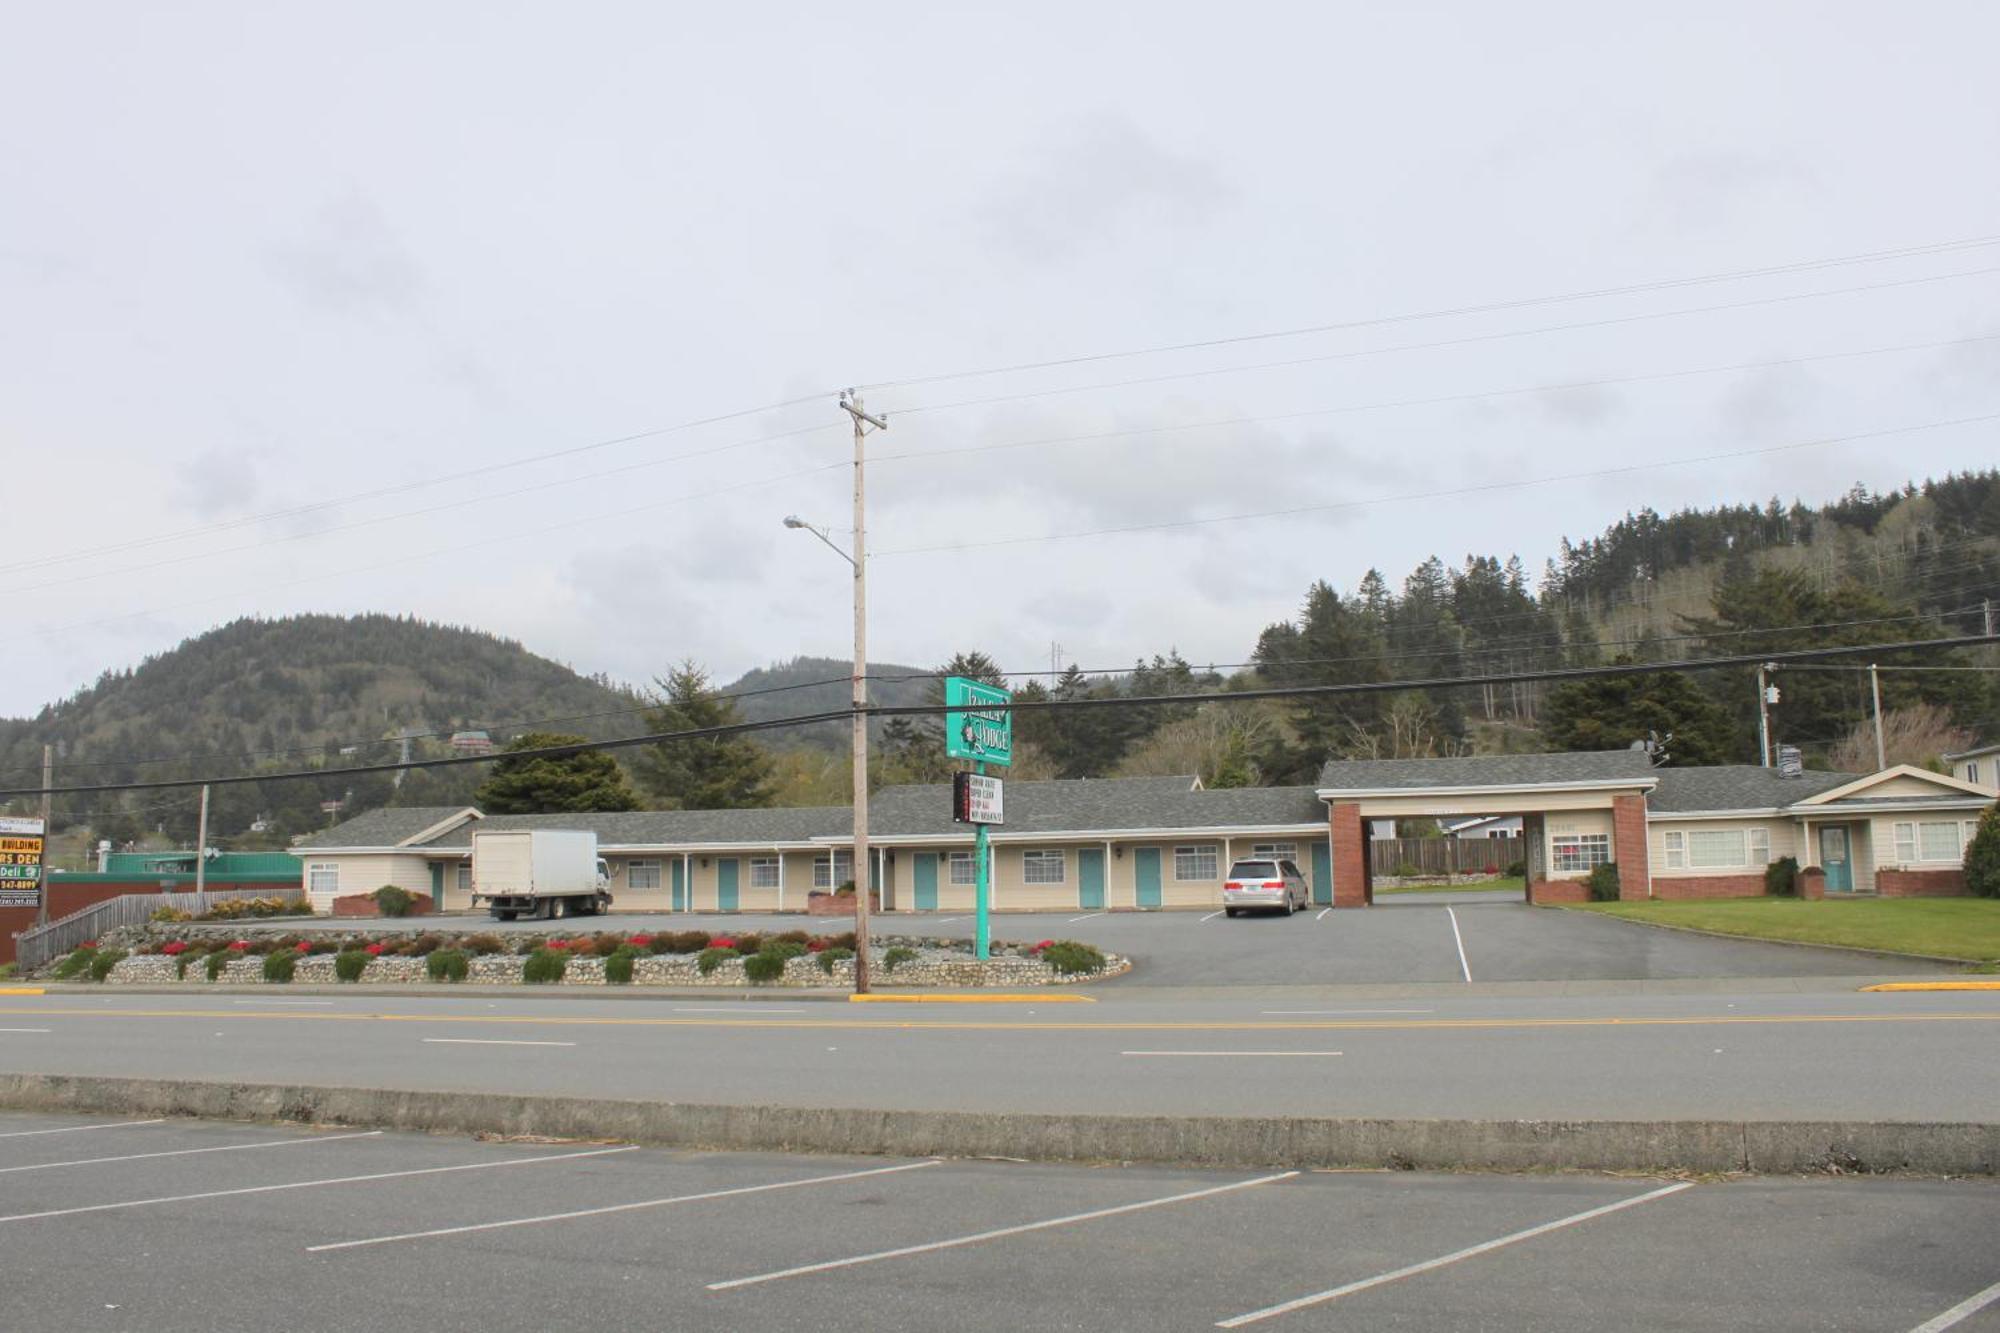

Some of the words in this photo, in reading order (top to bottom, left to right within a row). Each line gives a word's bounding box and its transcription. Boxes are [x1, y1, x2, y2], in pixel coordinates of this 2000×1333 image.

[976, 719, 1008, 753] LODGE
[2, 839, 40, 850] BUILDING
[17, 854, 39, 864] DEN
[0, 866, 21, 876] Deli
